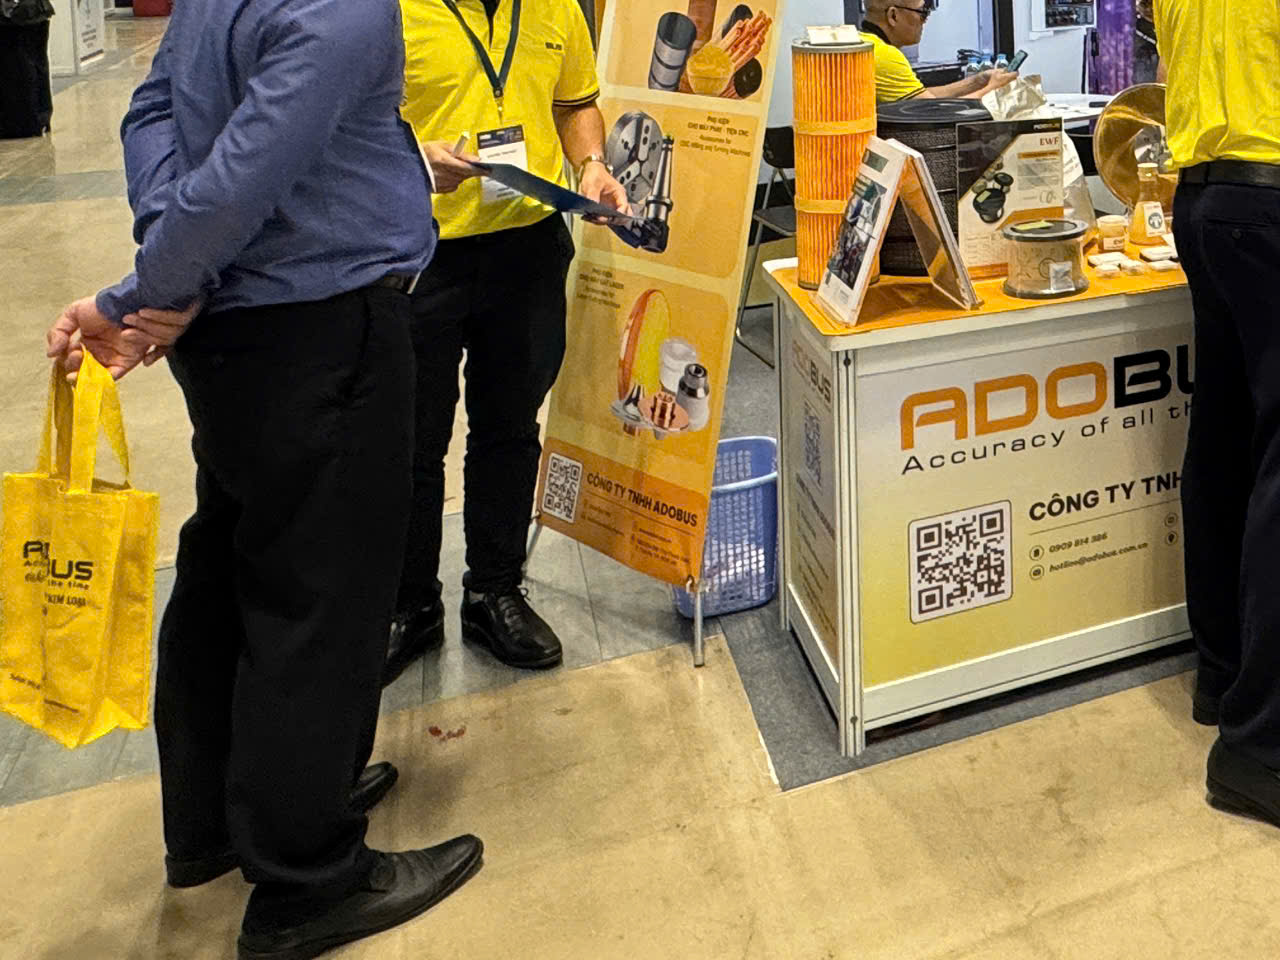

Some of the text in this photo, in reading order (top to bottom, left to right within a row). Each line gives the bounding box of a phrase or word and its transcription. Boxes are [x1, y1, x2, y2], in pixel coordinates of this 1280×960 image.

[900, 344, 1196, 451] ADOB
[901, 429, 1065, 476] Accuracy
[1080, 416, 1109, 438] of
[1122, 407, 1154, 430] all
[587, 472, 613, 494] CÔNG
[614, 483, 627, 498] TY
[653, 500, 698, 528] ADOBUS
[1028, 489, 1100, 521] CÔNG
[1104, 480, 1136, 503] TY
